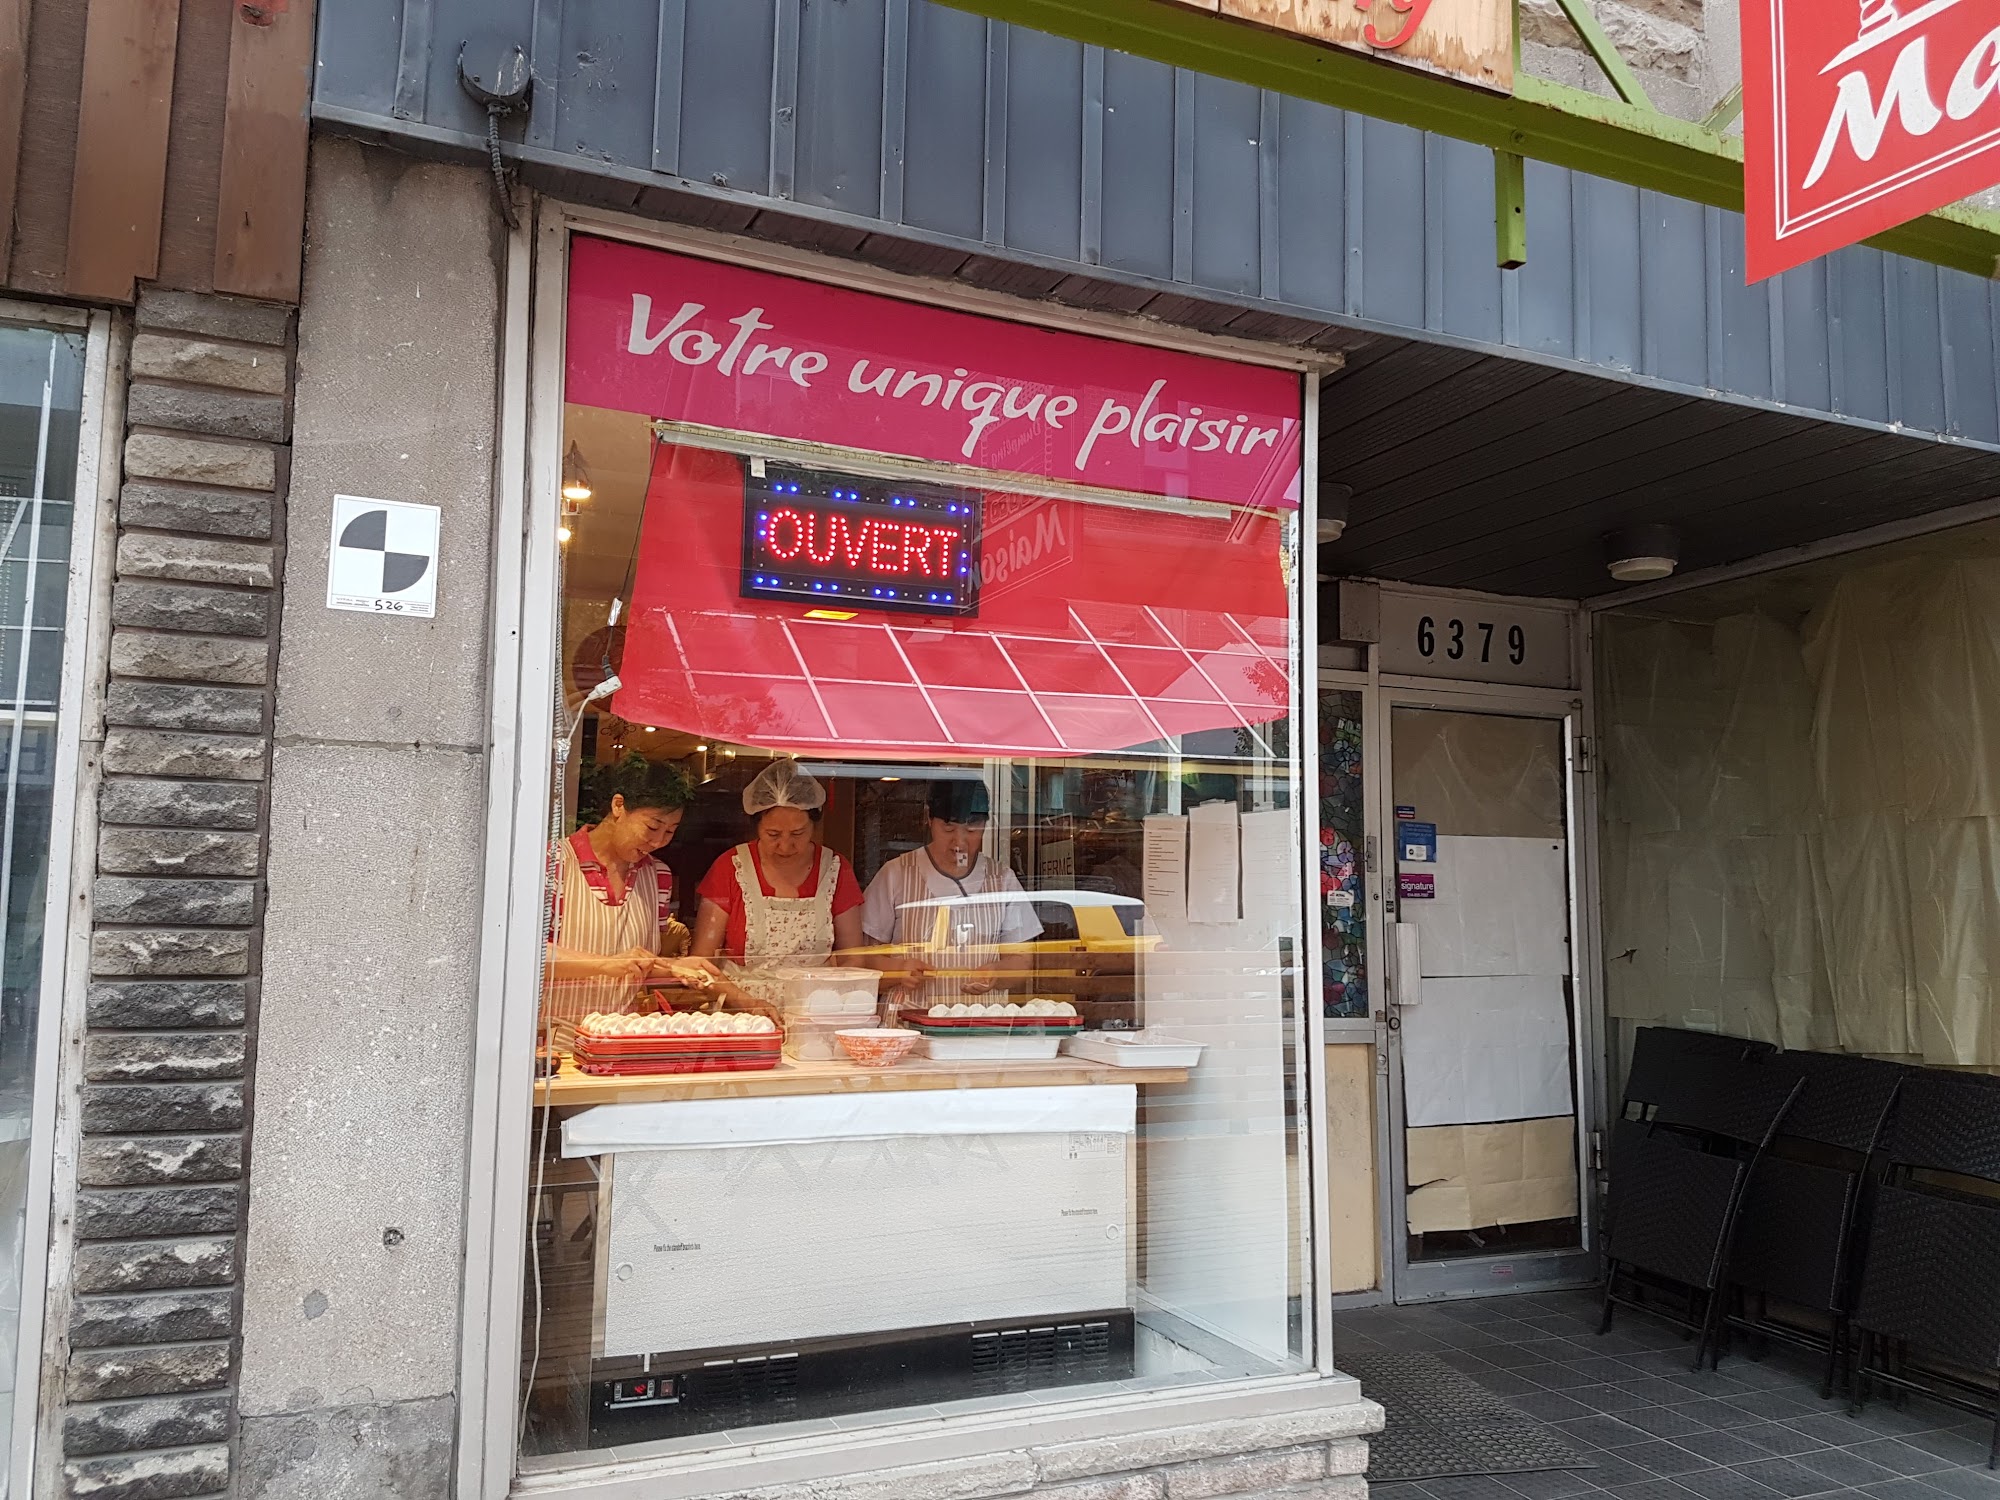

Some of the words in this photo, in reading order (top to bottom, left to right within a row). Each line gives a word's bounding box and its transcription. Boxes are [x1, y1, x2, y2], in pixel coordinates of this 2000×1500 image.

[627, 292, 828, 387] Votre
[847, 357, 1078, 458] unique
[1074, 379, 1282, 470] plaisir
[768, 508, 959, 577] OUVERT
[374, 599, 404, 612] 526
[1417, 616, 1525, 665] 6379
[1400, 881, 1434, 892] signature
